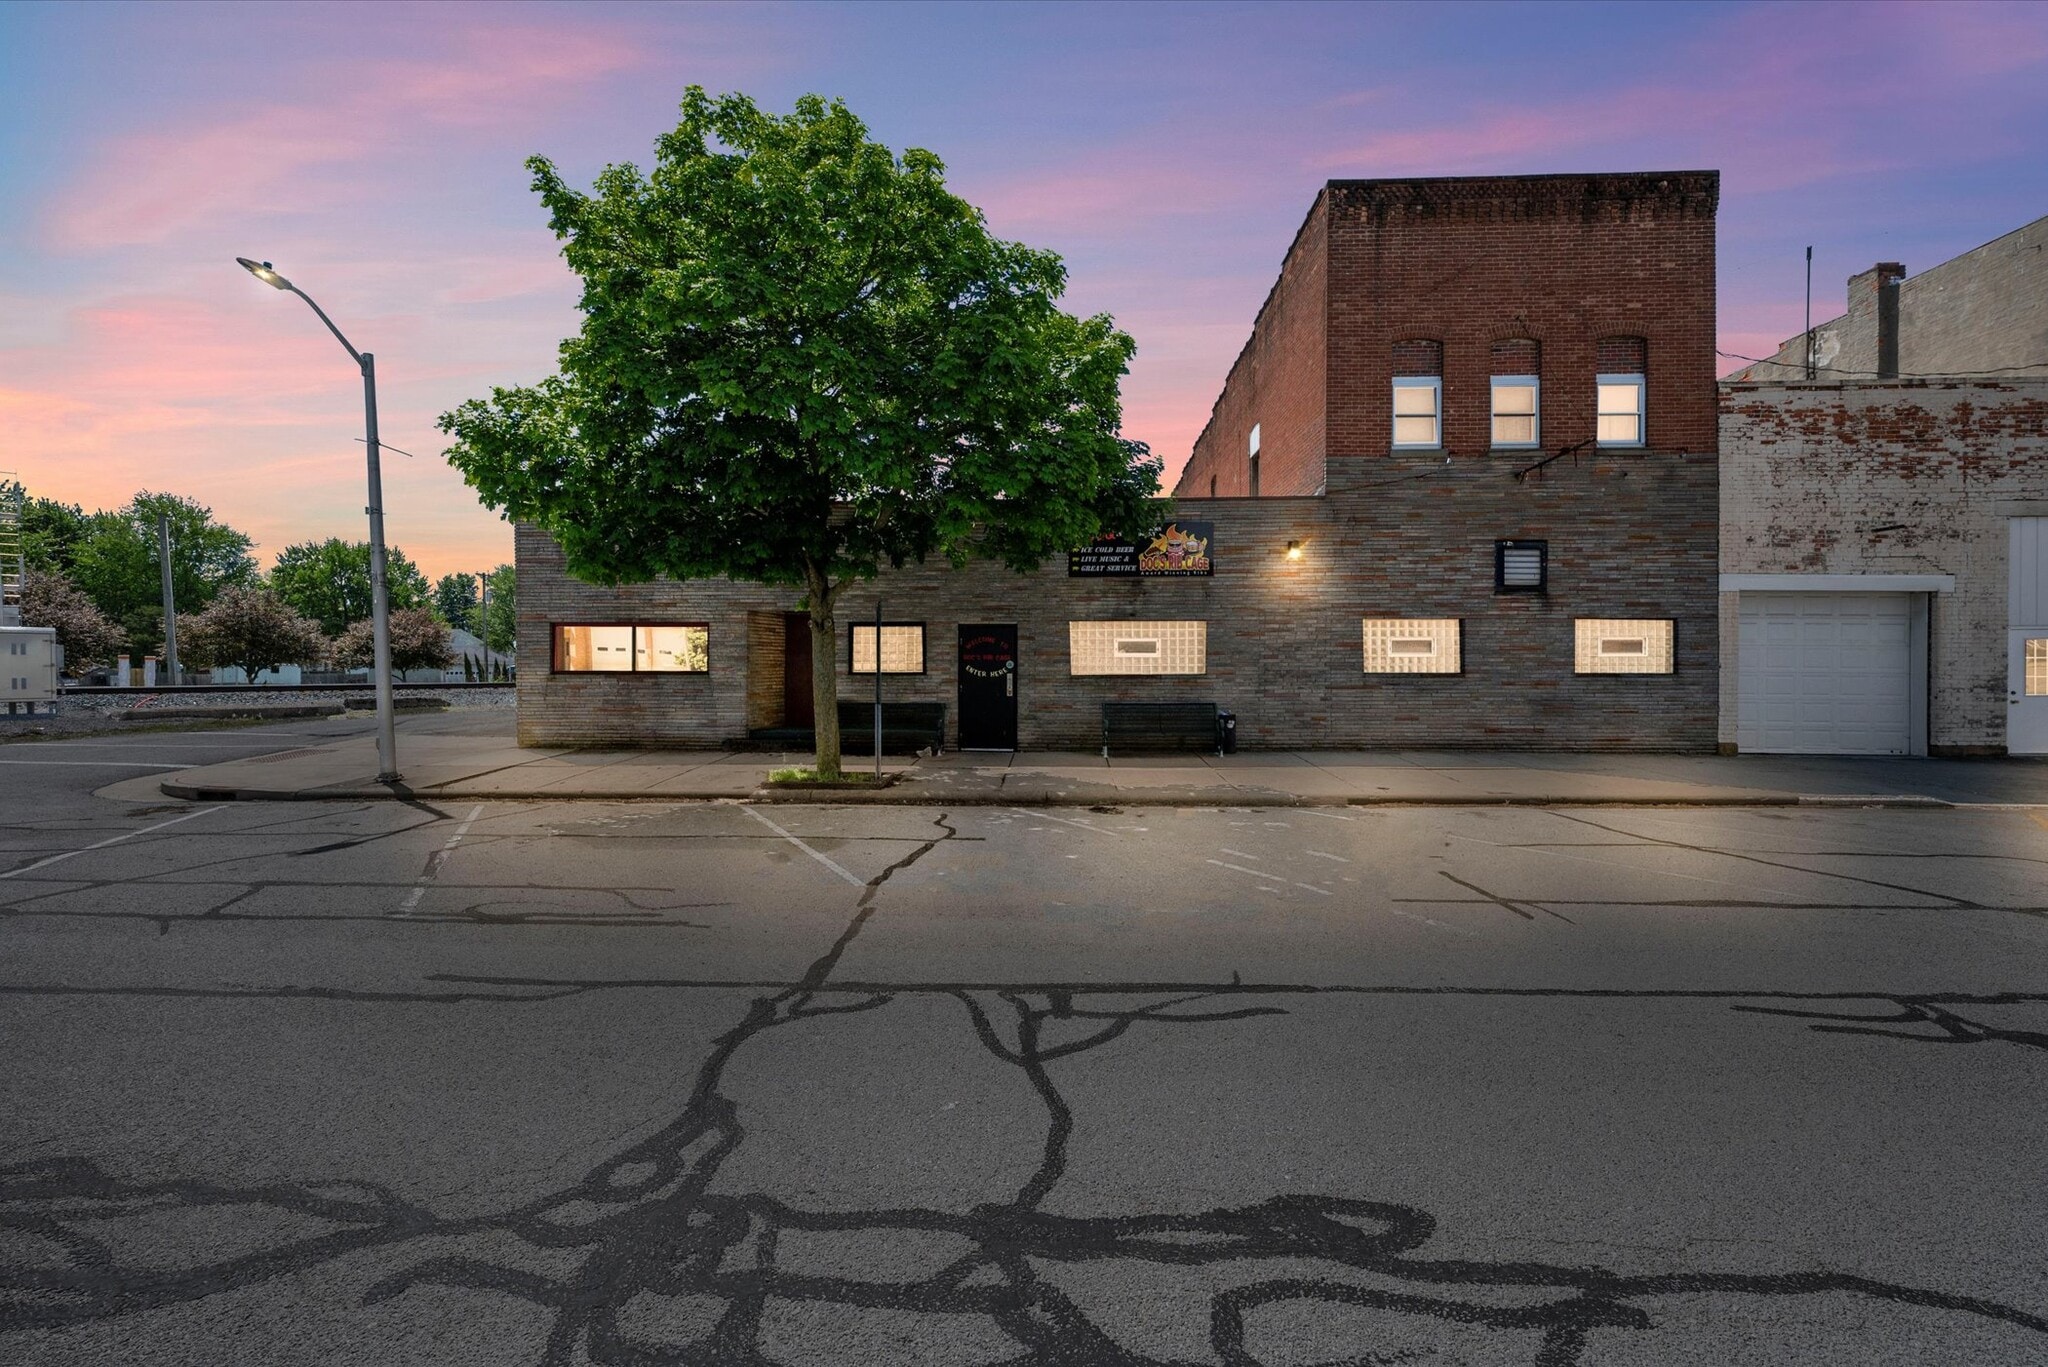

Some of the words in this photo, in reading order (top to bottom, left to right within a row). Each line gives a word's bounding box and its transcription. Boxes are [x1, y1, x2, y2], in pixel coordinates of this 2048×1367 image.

[1080, 555, 1098, 563] LIVE
[1098, 555, 1122, 563] MUSIC
[1140, 556, 1166, 570] DOC'S
[1167, 554, 1183, 570] RIB
[1185, 556, 1210, 570] CAGE
[1106, 564, 1137, 572] SERVICE
[964, 635, 995, 650] WELCOME
[965, 664, 987, 678] ENTER
[990, 666, 1008, 678] HERE
